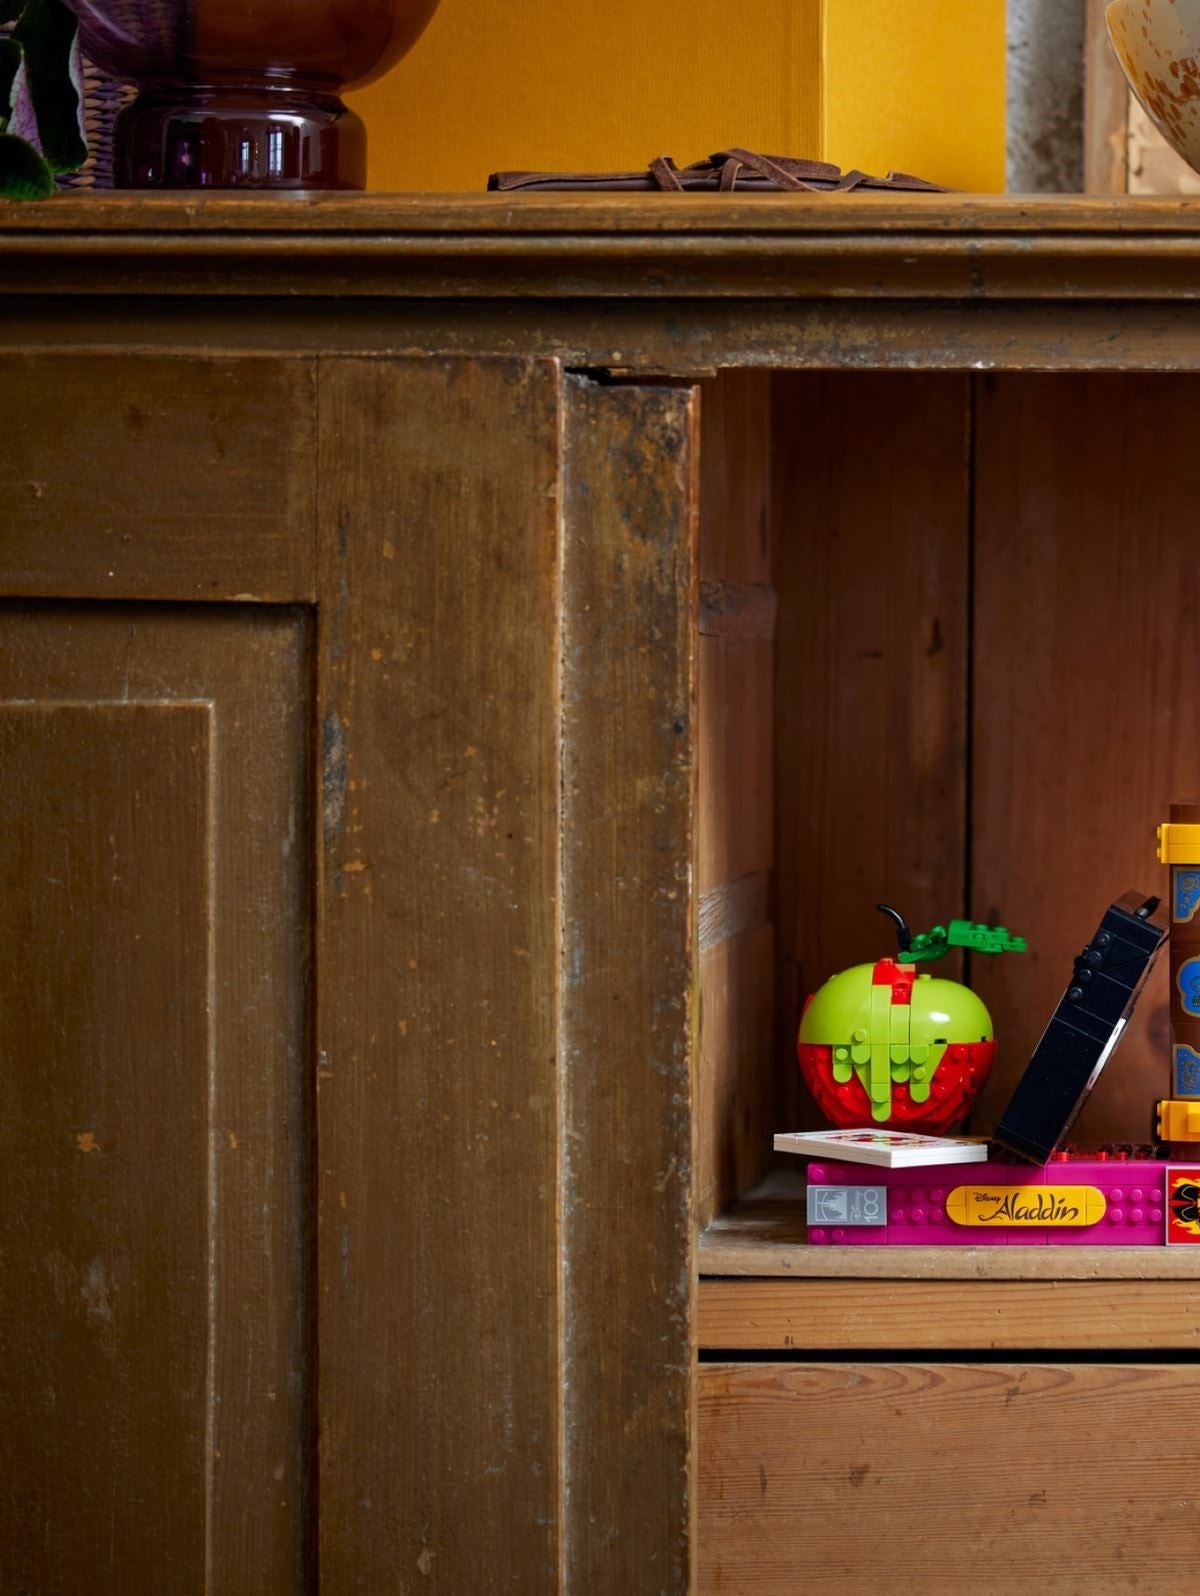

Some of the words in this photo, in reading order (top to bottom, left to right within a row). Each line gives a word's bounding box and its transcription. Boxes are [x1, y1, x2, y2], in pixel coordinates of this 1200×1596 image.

[850, 1190, 864, 1220] Disney
[864, 1189, 878, 1222] 100
[973, 1192, 1001, 1204] Disney
[978, 1192, 1079, 1221] Aladdin
